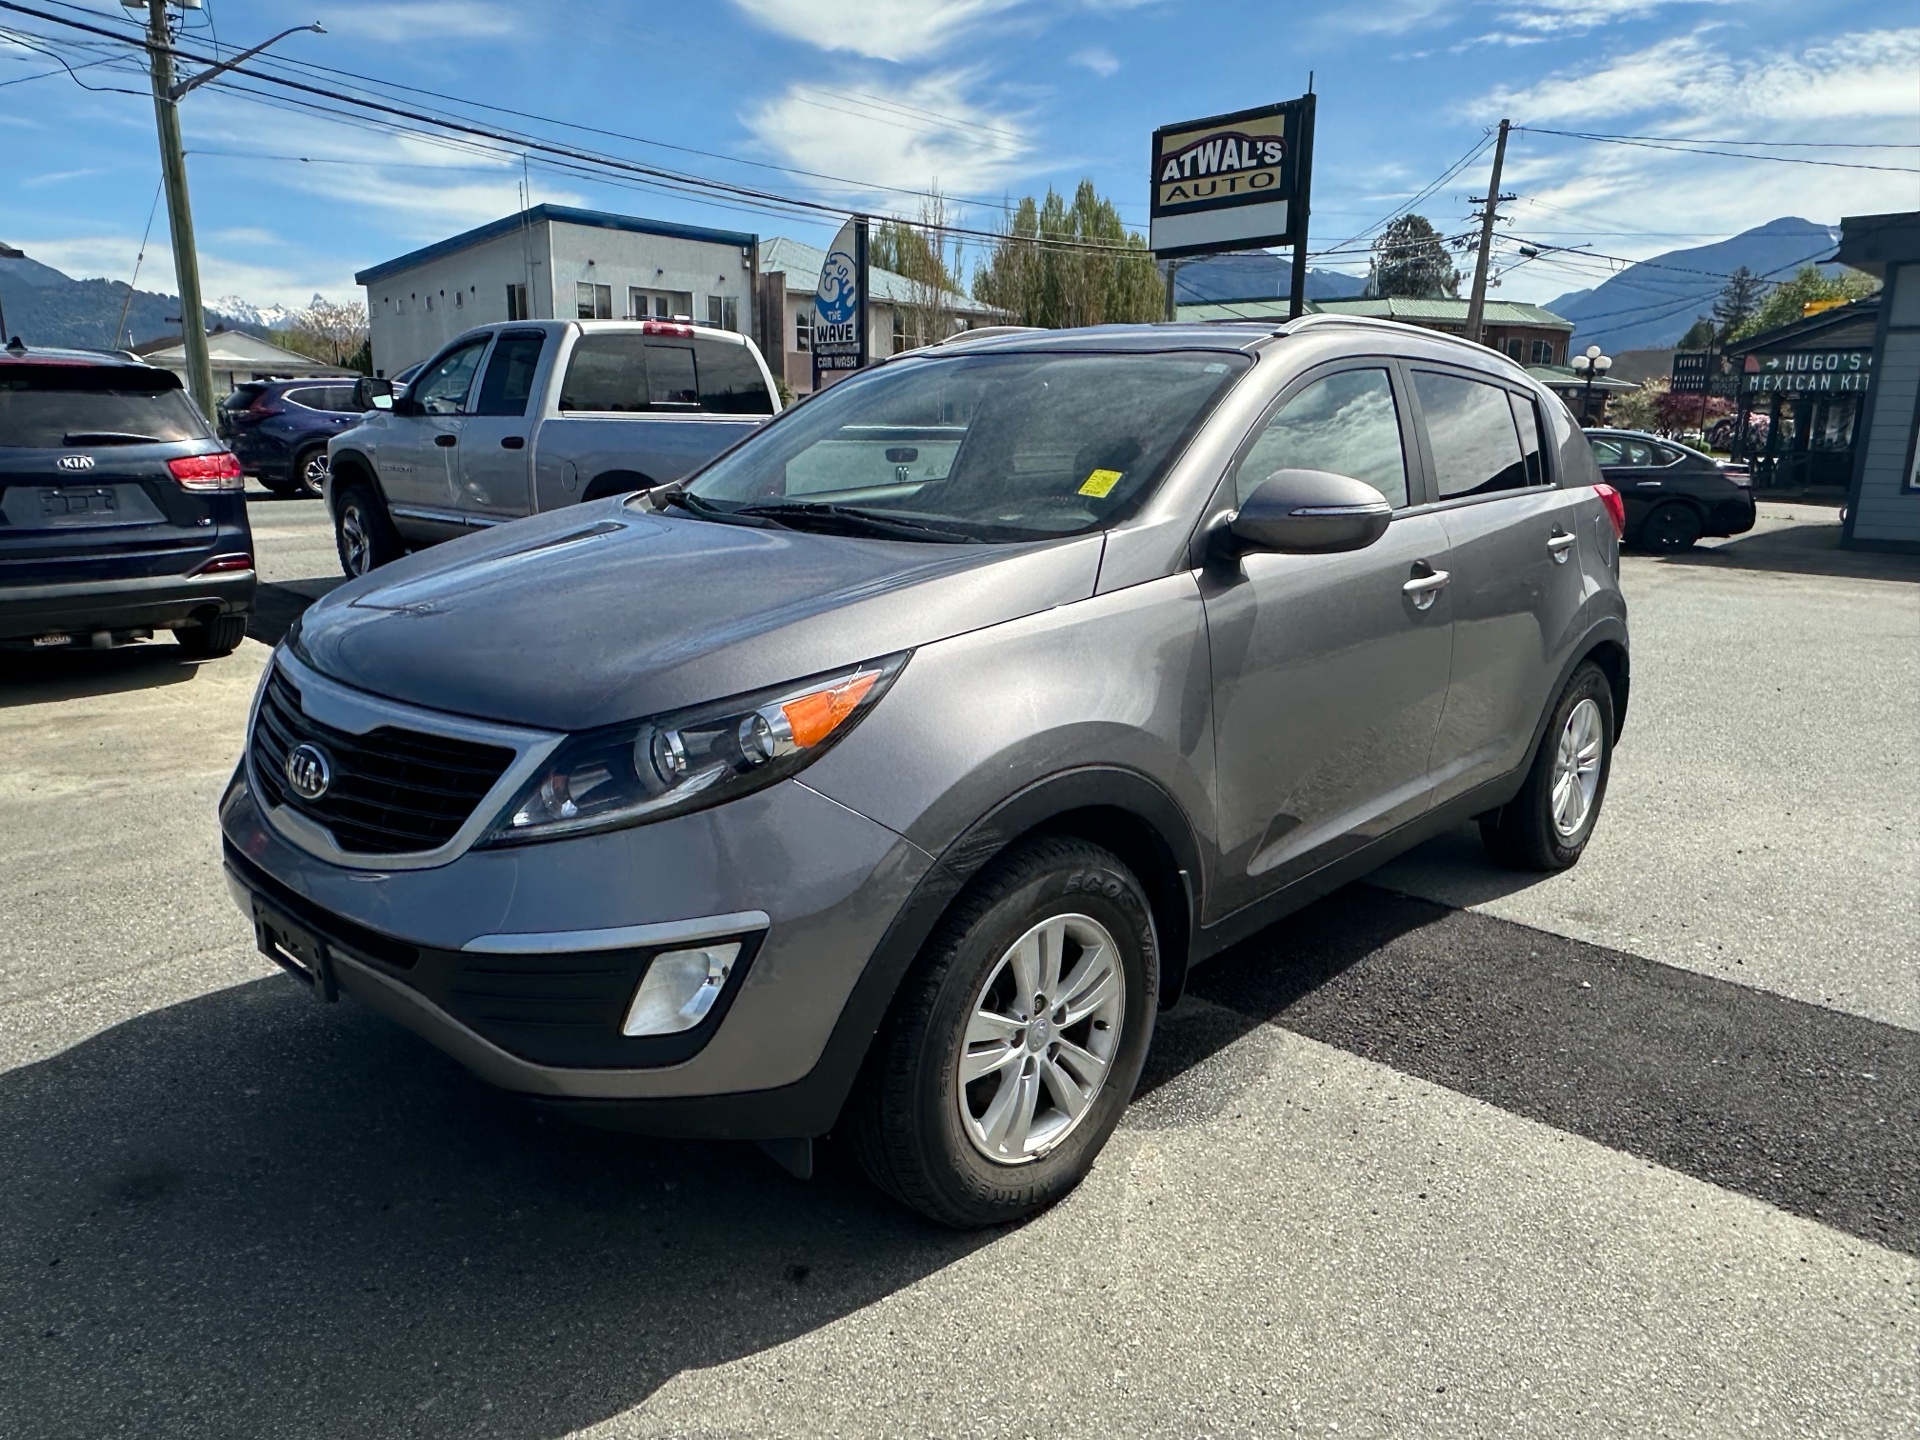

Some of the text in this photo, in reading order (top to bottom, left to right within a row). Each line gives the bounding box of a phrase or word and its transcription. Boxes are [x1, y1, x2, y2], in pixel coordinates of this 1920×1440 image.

[1162, 138, 1283, 182] ATWAL'S
[1166, 172, 1275, 202] AUTO
[827, 310, 842, 321] THE
[817, 323, 853, 342] WAVE
[817, 355, 857, 368] CAR WASH
[1785, 353, 1862, 371] HUGO'S
[1749, 374, 1831, 391] MEXICAN
[62, 455, 94, 469] KIA
[289, 753, 317, 791] KIA
